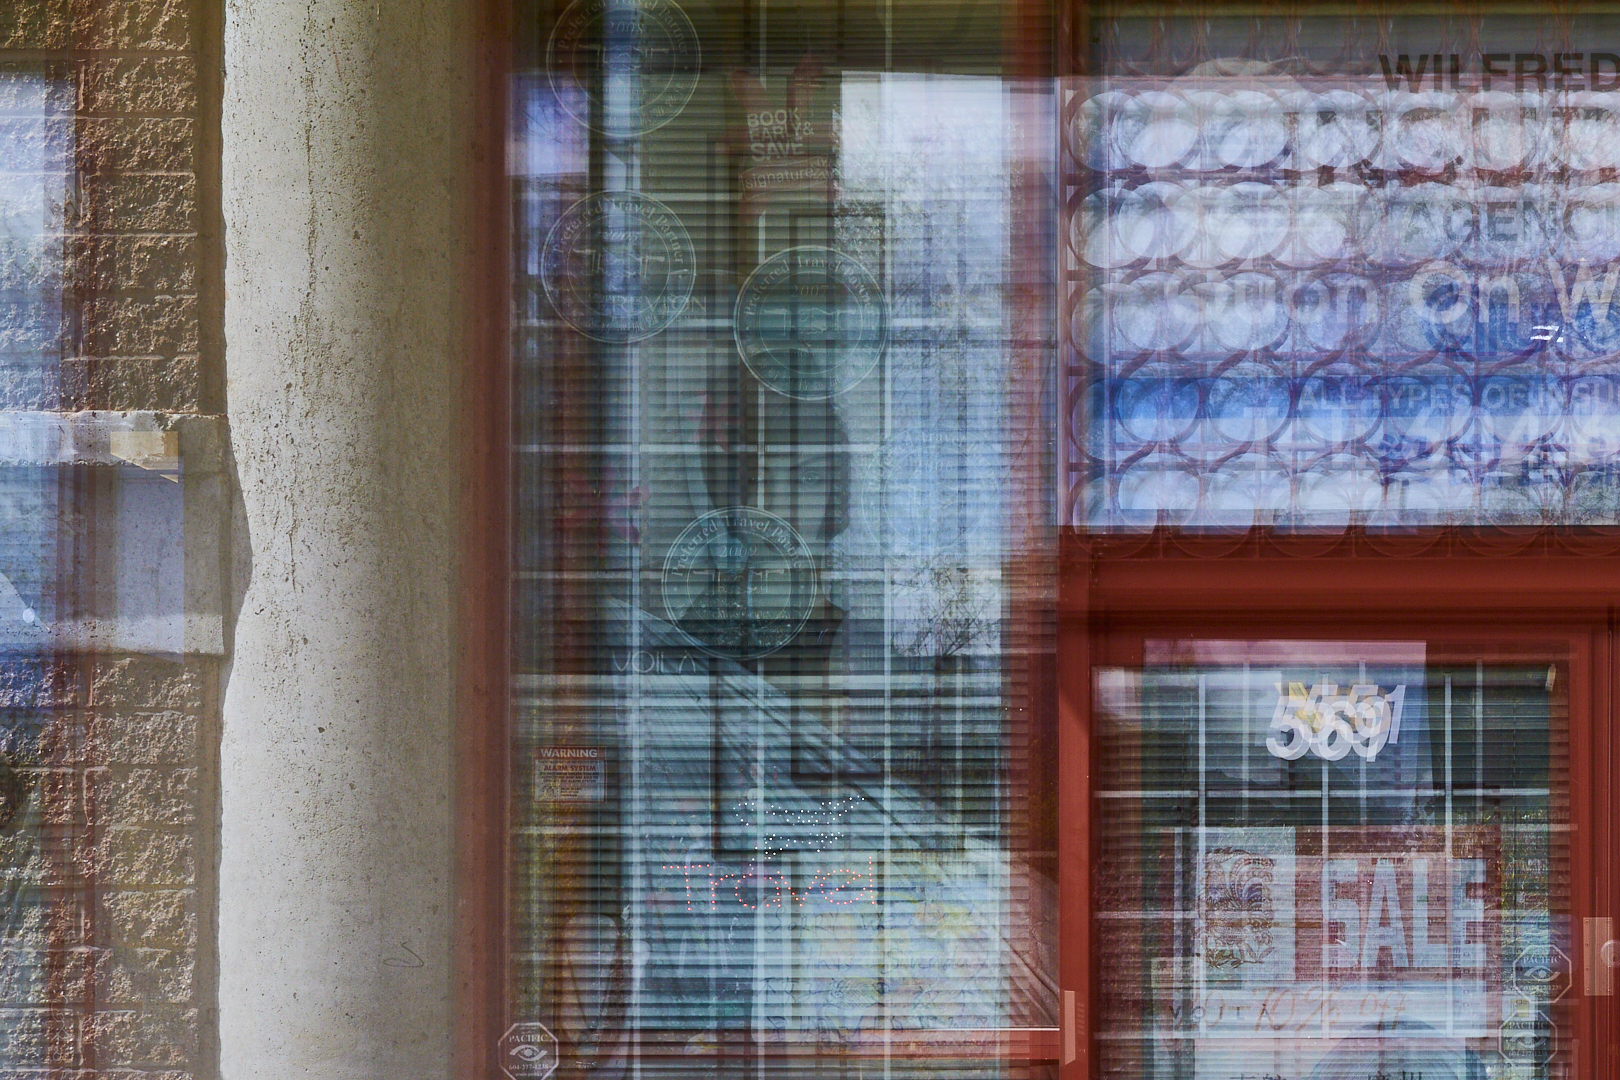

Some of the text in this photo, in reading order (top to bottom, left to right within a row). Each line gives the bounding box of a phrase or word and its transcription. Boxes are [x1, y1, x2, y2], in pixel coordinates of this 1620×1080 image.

[747, 106, 800, 128] BOOK
[750, 142, 805, 161] SAVE
[1408, 262, 1527, 328] On
[671, 519, 718, 577] Preferred
[540, 748, 598, 758] WARNING
[662, 856, 876, 913] Travel
[1321, 858, 1488, 969] SALE
[1522, 956, 1561, 964] PACIFIC
[1508, 1021, 1549, 1030] PACIFIC
[509, 1033, 549, 1043] PACIFIC
